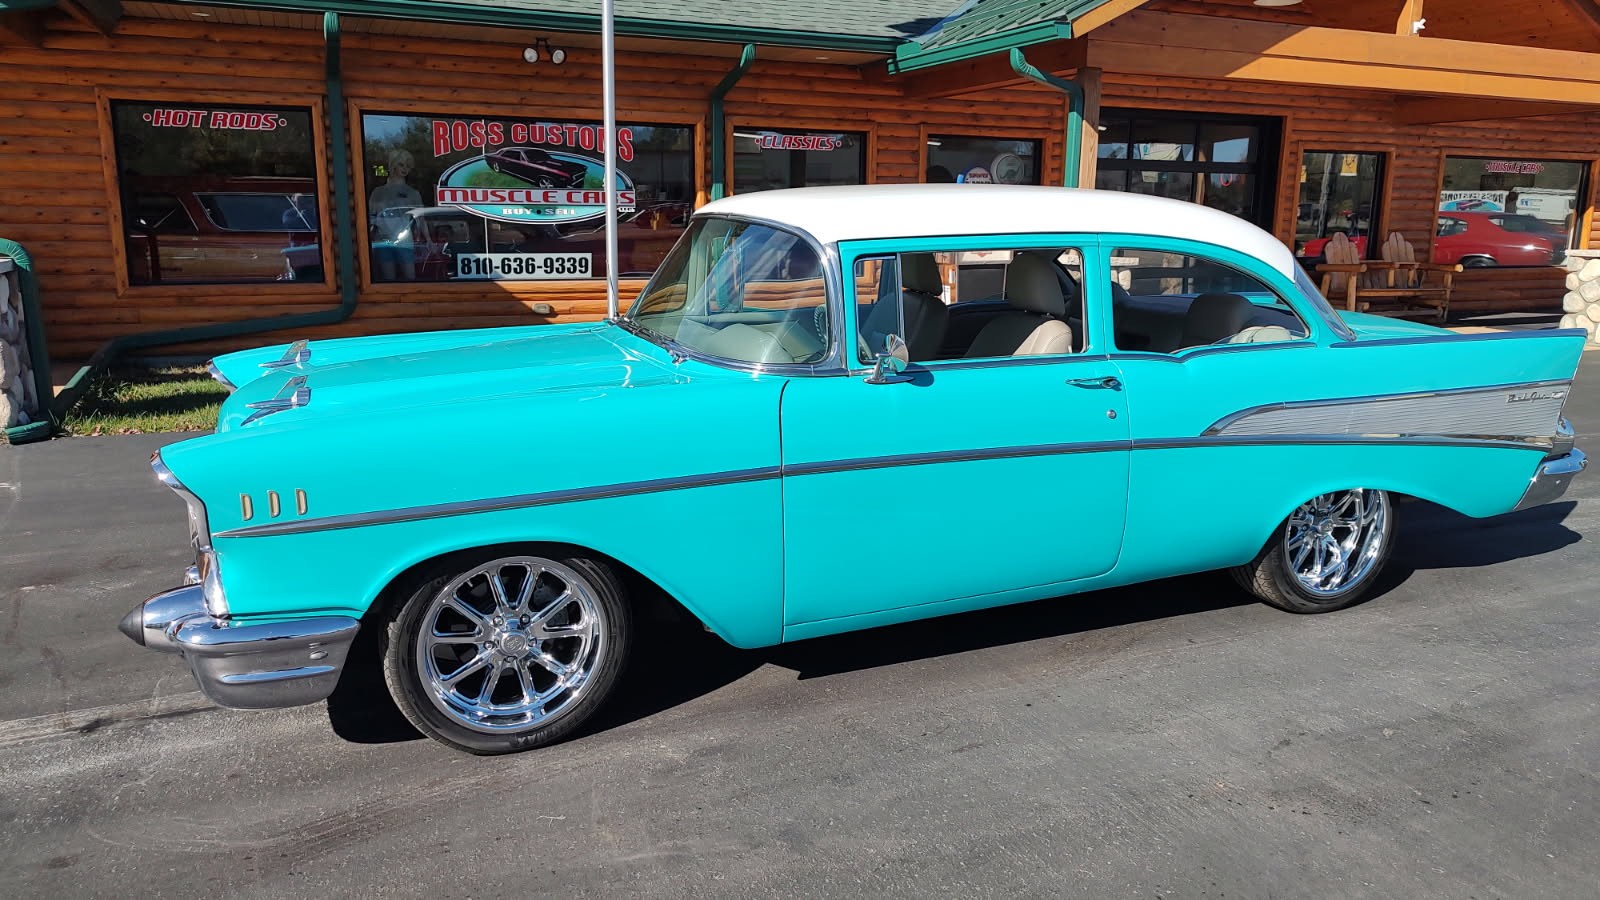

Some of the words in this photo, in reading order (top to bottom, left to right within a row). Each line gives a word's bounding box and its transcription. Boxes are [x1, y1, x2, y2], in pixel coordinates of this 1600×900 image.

[152, 108, 208, 127] HOT
[210, 111, 278, 130] RODS
[433, 120, 504, 157] ROSS
[761, 135, 836, 150] CLASSICS
[438, 188, 558, 203] MUSCLE
[460, 257, 589, 275] 810-636-9339
